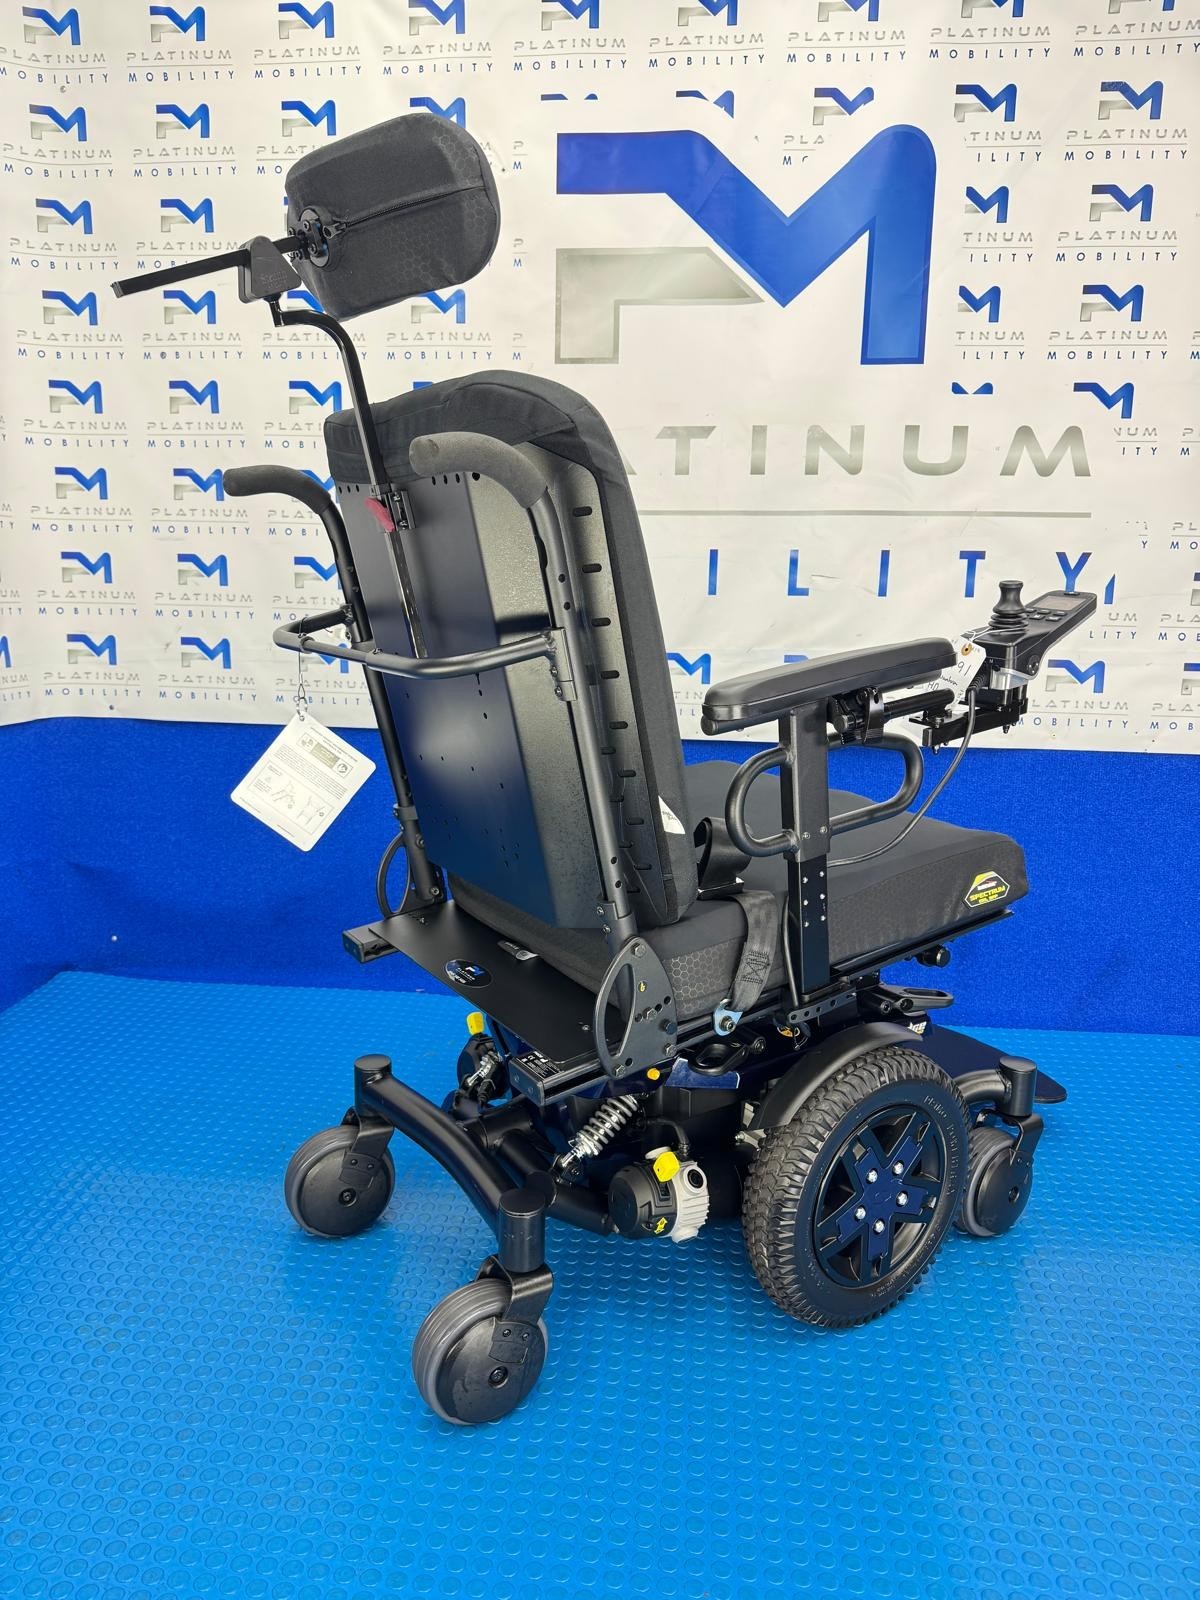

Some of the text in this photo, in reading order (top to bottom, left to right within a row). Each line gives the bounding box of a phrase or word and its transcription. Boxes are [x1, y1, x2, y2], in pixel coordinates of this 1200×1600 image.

[931, 26, 1050, 37] PLATINUM
[1075, 19, 1200, 36] PLATINUM
[648, 33, 763, 47] PLATINUM
[788, 30, 905, 41] PLATINUM
[383, 42, 492, 56] PLATINUM
[514, 38, 627, 50] PLATINUM
[254, 46, 360, 59] PLATINUM
[929, 48, 1050, 60] MOBILITY
[1073, 43, 1200, 57] MOBILITY
[127, 50, 231, 61] PLATINUM
[649, 54, 764, 67] MOBILITY
[787, 51, 907, 62] MOBILITY
[383, 62, 492, 75] MOBILITY
[514, 59, 626, 72] MOBILITY
[129, 71, 234, 82] MOBILITY
[255, 66, 361, 78] MOBILITY
[965, 130, 1043, 141] TINUM
[1067, 129, 1187, 140] PLATINUM
[3, 143, 112, 160] PLATINUM
[133, 146, 234, 157] PLATINUM
[256, 145, 308, 155] PLAT
[1065, 150, 1187, 160] MOBILITY
[976, 152, 1041, 162] ILITY
[5, 164, 113, 178] MOBILITY
[134, 167, 236, 177] MOBILITY
[963, 232, 1032, 242] TINUM
[1058, 231, 1177, 241] PLATINUM
[10, 238, 118, 252] PLATINUM
[970, 253, 1033, 262] ILITY
[1056, 252, 1177, 261] MOBILITY
[11, 257, 120, 270] MOBILITY
[17, 330, 122, 342] PLATINUM
[142, 332, 240, 342] PLATINUM
[387, 332, 491, 341] PLATINUM
[956, 331, 1024, 340] TINUM
[1049, 331, 1167, 340] PLATINUM
[18, 348, 124, 360] MOBILITY
[387, 351, 491, 360] MOBILITY
[963, 351, 1024, 359] ILITY
[1047, 351, 1167, 359] MOBILITY
[24, 419, 126, 430] PLATINUM
[147, 422, 243, 430] PLATINUM
[264, 422, 322, 431] PLATI
[25, 437, 128, 447] MOBILITY
[148, 440, 245, 448] MOBILITY
[265, 440, 316, 448] MOBI
[620, 424, 1092, 477] TINUM
[31, 506, 132, 516] PLATINUM
[152, 508, 248, 517] PLATINUM
[32, 522, 133, 532] MOBILITY
[152, 525, 250, 534] MOBILITY
[269, 528, 318, 536] MOBI
[706, 548, 1092, 598] ILITY
[37, 590, 135, 600] PLATINUM
[155, 592, 252, 602] PLATINUM
[39, 607, 137, 616] MOBILITY
[156, 609, 254, 619] MOBILITY
[43, 672, 140, 682] PLATINUM
[158, 674, 255, 685] PLATINUM
[45, 687, 141, 697] MOBILITY
[159, 690, 256, 701] MOBILITY
[1031, 699, 1129, 710] LATINUM
